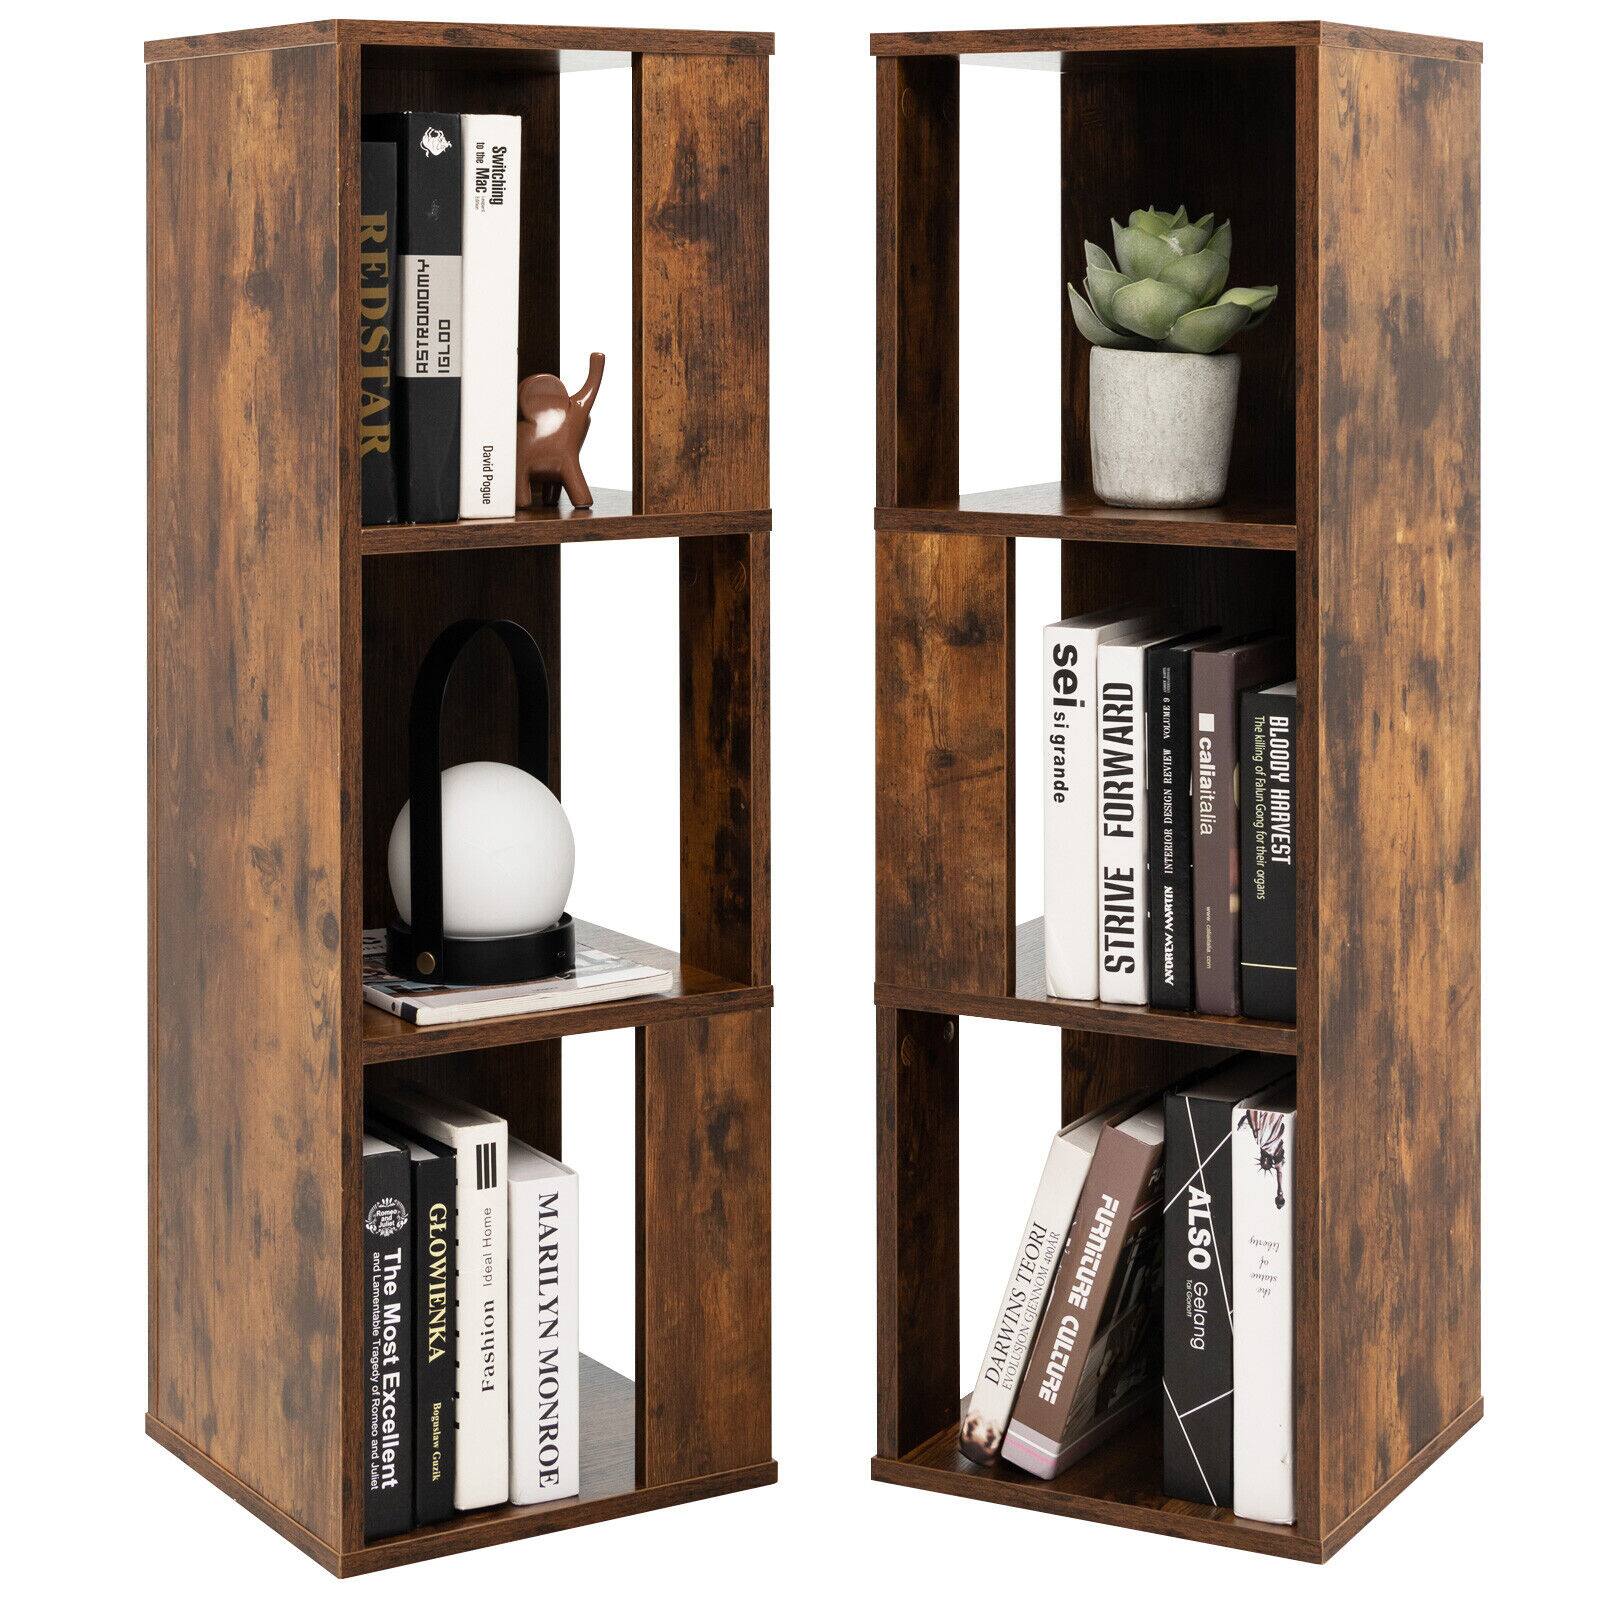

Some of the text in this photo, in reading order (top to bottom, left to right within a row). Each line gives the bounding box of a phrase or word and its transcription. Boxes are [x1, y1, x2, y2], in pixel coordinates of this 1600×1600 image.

[475, 168, 490, 193] Mac
[476, 142, 485, 150] to
[476, 152, 485, 164] the
[489, 146, 507, 205] Switching
[416, 259, 430, 374] ASTRONOMY
[438, 319, 451, 373] IGLOO
[480, 445, 494, 505] David Pogue
[1050, 643, 1085, 803] sei si grande
[1163, 705, 1171, 739] VOLUME
[1163, 748, 1172, 784] REVIEW
[1103, 682, 1135, 974] STRIVE FORWARD
[1163, 789, 1173, 824] DESIGN
[1199, 737, 1216, 836] caliaitalia
[1252, 715, 1267, 900] The killing of Falun Gong for their organs
[1269, 716, 1291, 865] BLOODY HARVEST
[1164, 829, 1173, 874] INTERIOR
[1164, 885, 1174, 931] MARTIN
[1164, 932, 1174, 986] ANDREW
[428, 1203, 448, 1364] GŁOWIENKA
[481, 1207, 495, 1392] Fashion Ideal Home
[984, 1221, 1048, 1386] DARWINS TEORI
[1188, 1185, 1211, 1350] ALSO Gelang
[370, 1252, 381, 1491] and Lamentable Tragedy of Romeo and Juliet
[381, 1247, 401, 1490] The Most Excellent
[538, 1191, 560, 1488] MARILYN MONROE
[1002, 1323, 1030, 1391] EVOLUSJON
[1024, 1266, 1049, 1323] GJENNOM
[1038, 1315, 1080, 1405] CULTURE
[432, 1451, 441, 1481] Guzik
